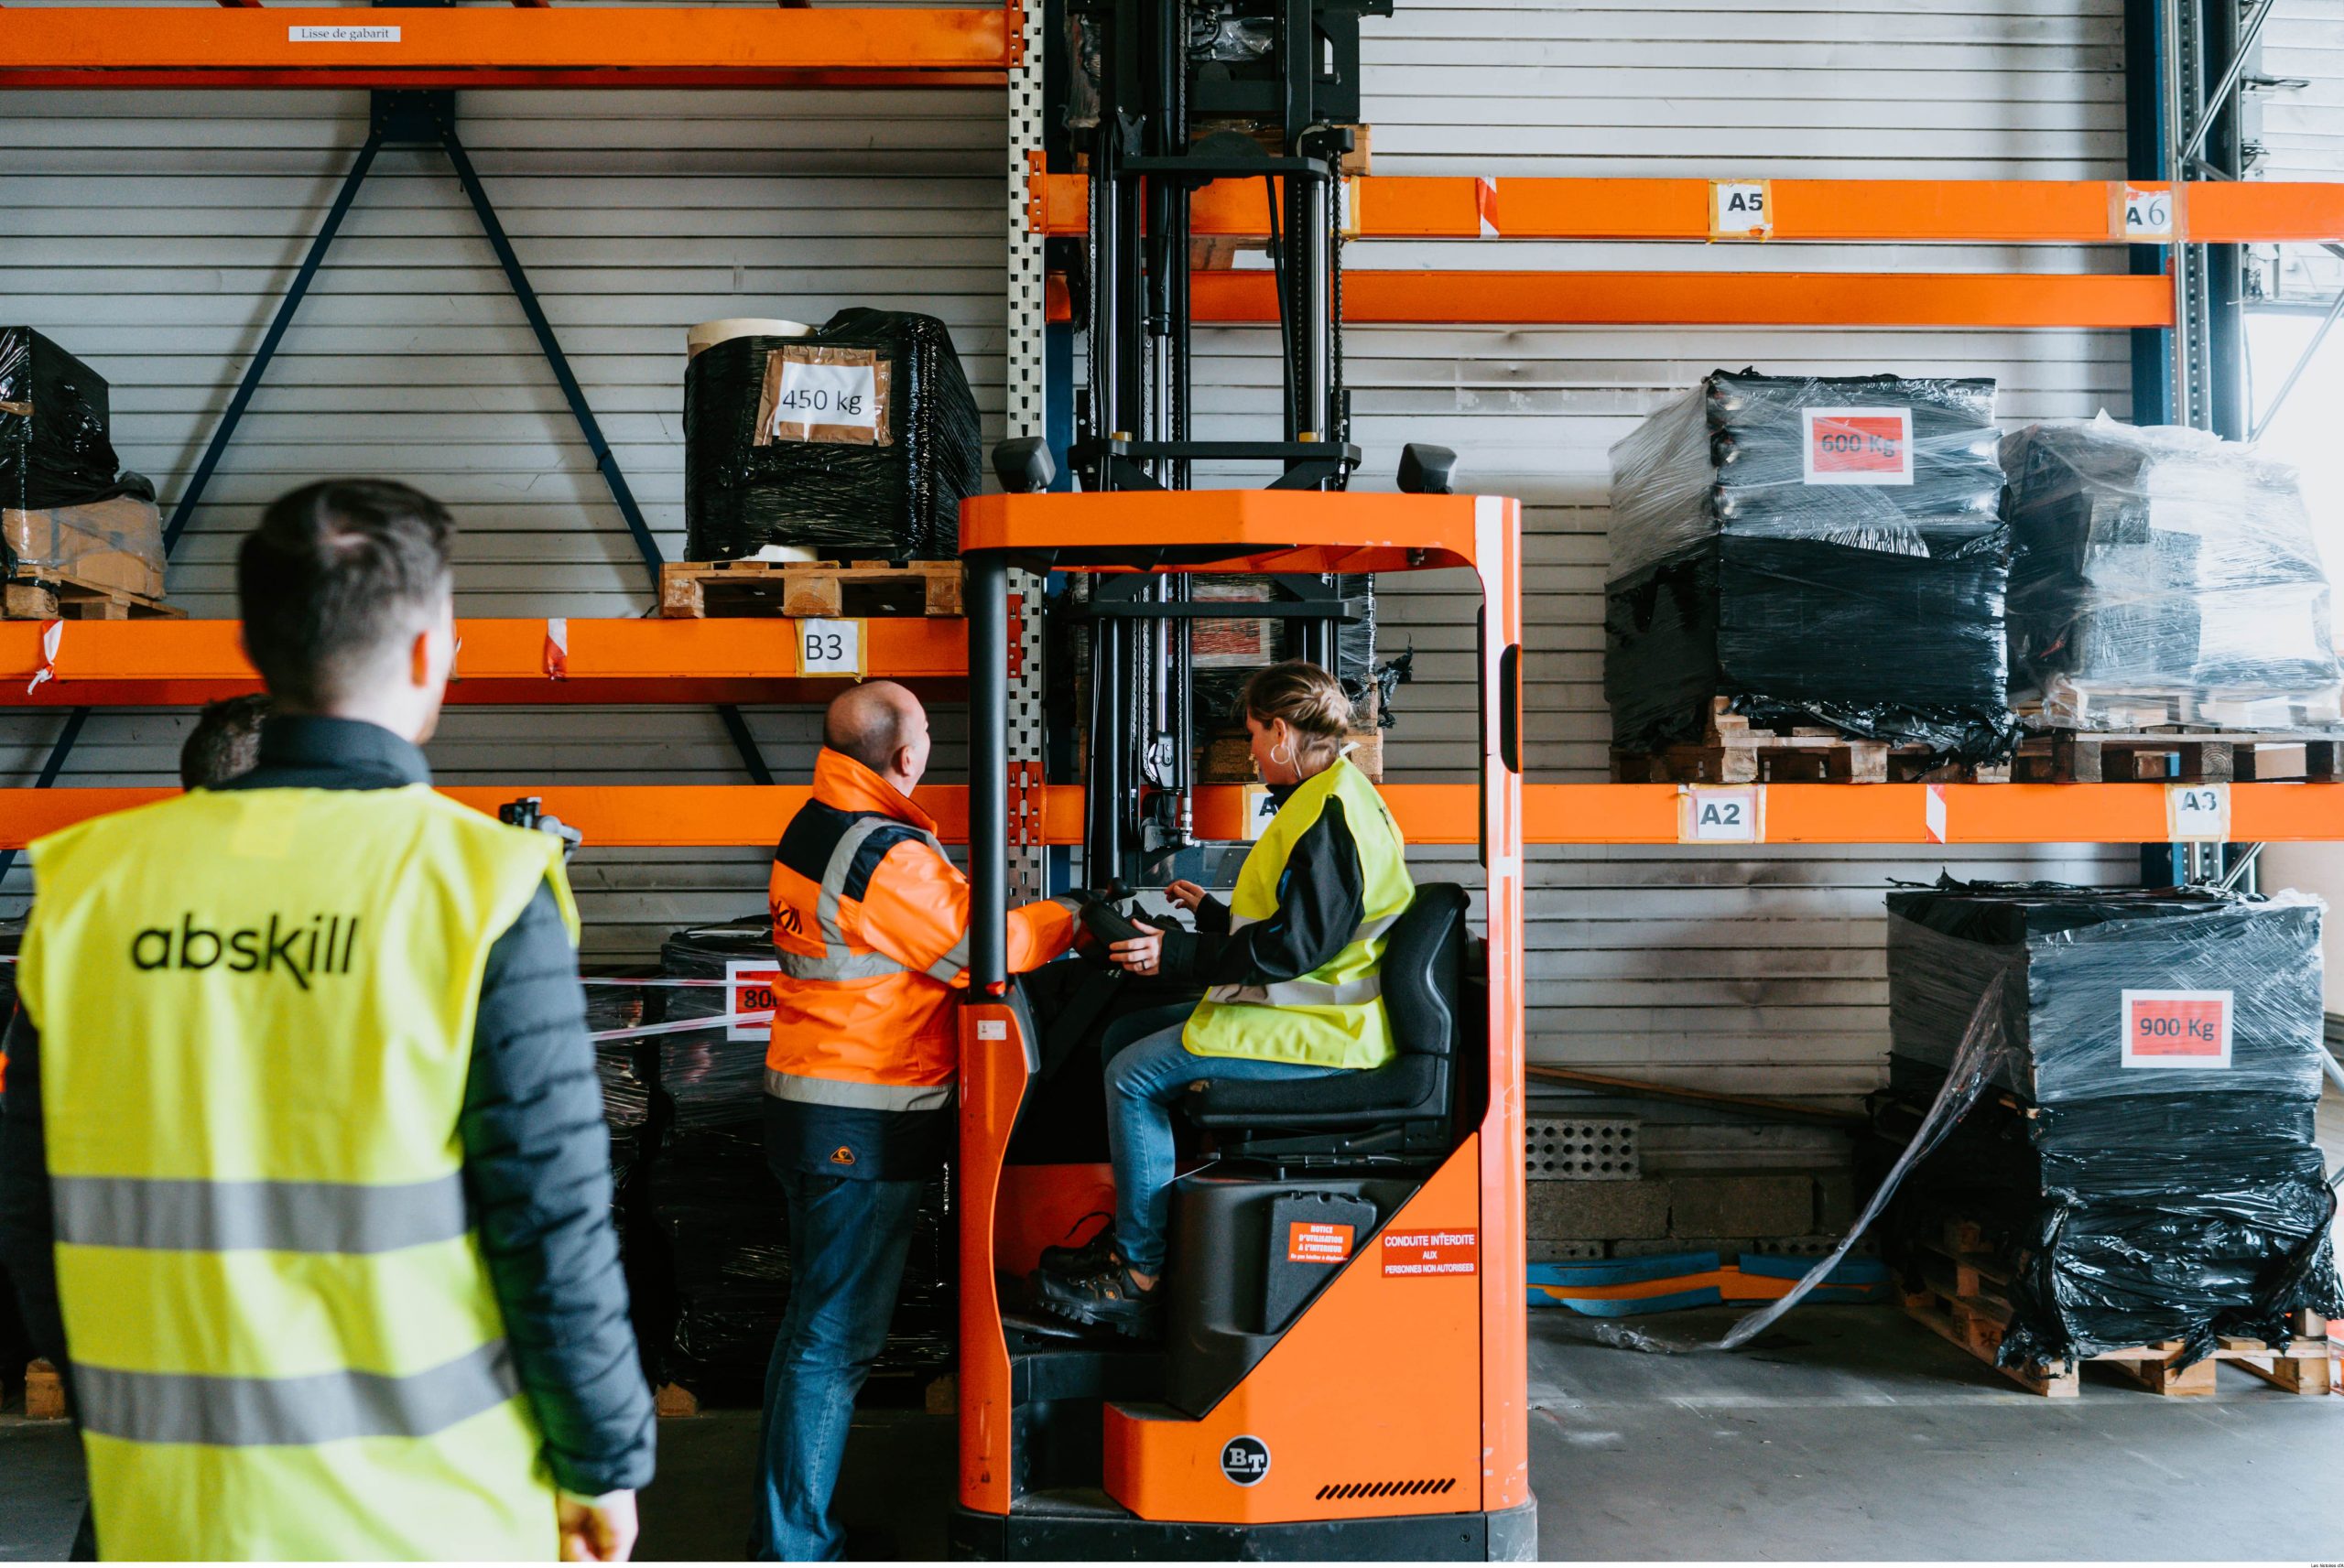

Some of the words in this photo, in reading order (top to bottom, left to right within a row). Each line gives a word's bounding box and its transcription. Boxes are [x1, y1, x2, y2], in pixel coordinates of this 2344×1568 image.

[301, 28, 330, 38] Lisse
[332, 28, 346, 38] de
[349, 27, 389, 41] gabarit
[1728, 192, 1763, 211] A5
[783, 390, 828, 410] 450
[837, 390, 863, 416] kg
[1821, 434, 1862, 453] 600
[1869, 434, 1896, 458] Kg
[806, 633, 843, 661] B3
[2181, 791, 2217, 811] A3
[1699, 803, 1741, 825] A2
[132, 912, 360, 992] abskill
[2140, 1017, 2181, 1037] 900
[2188, 1018, 2215, 1042] Kg
[1298, 1234, 1344, 1244] D'UTILISATION
[1310, 1225, 1334, 1234] NOTICE
[1384, 1235, 1428, 1247] CONDUITE
[1430, 1234, 1475, 1246] INTERDITE
[1422, 1250, 1438, 1260] AUX
[1384, 1265, 1422, 1274] PERSONNES
[1422, 1264, 1437, 1273] NON
[1437, 1263, 1474, 1272] AUTORISEES
[1229, 1447, 1264, 1473] BT
